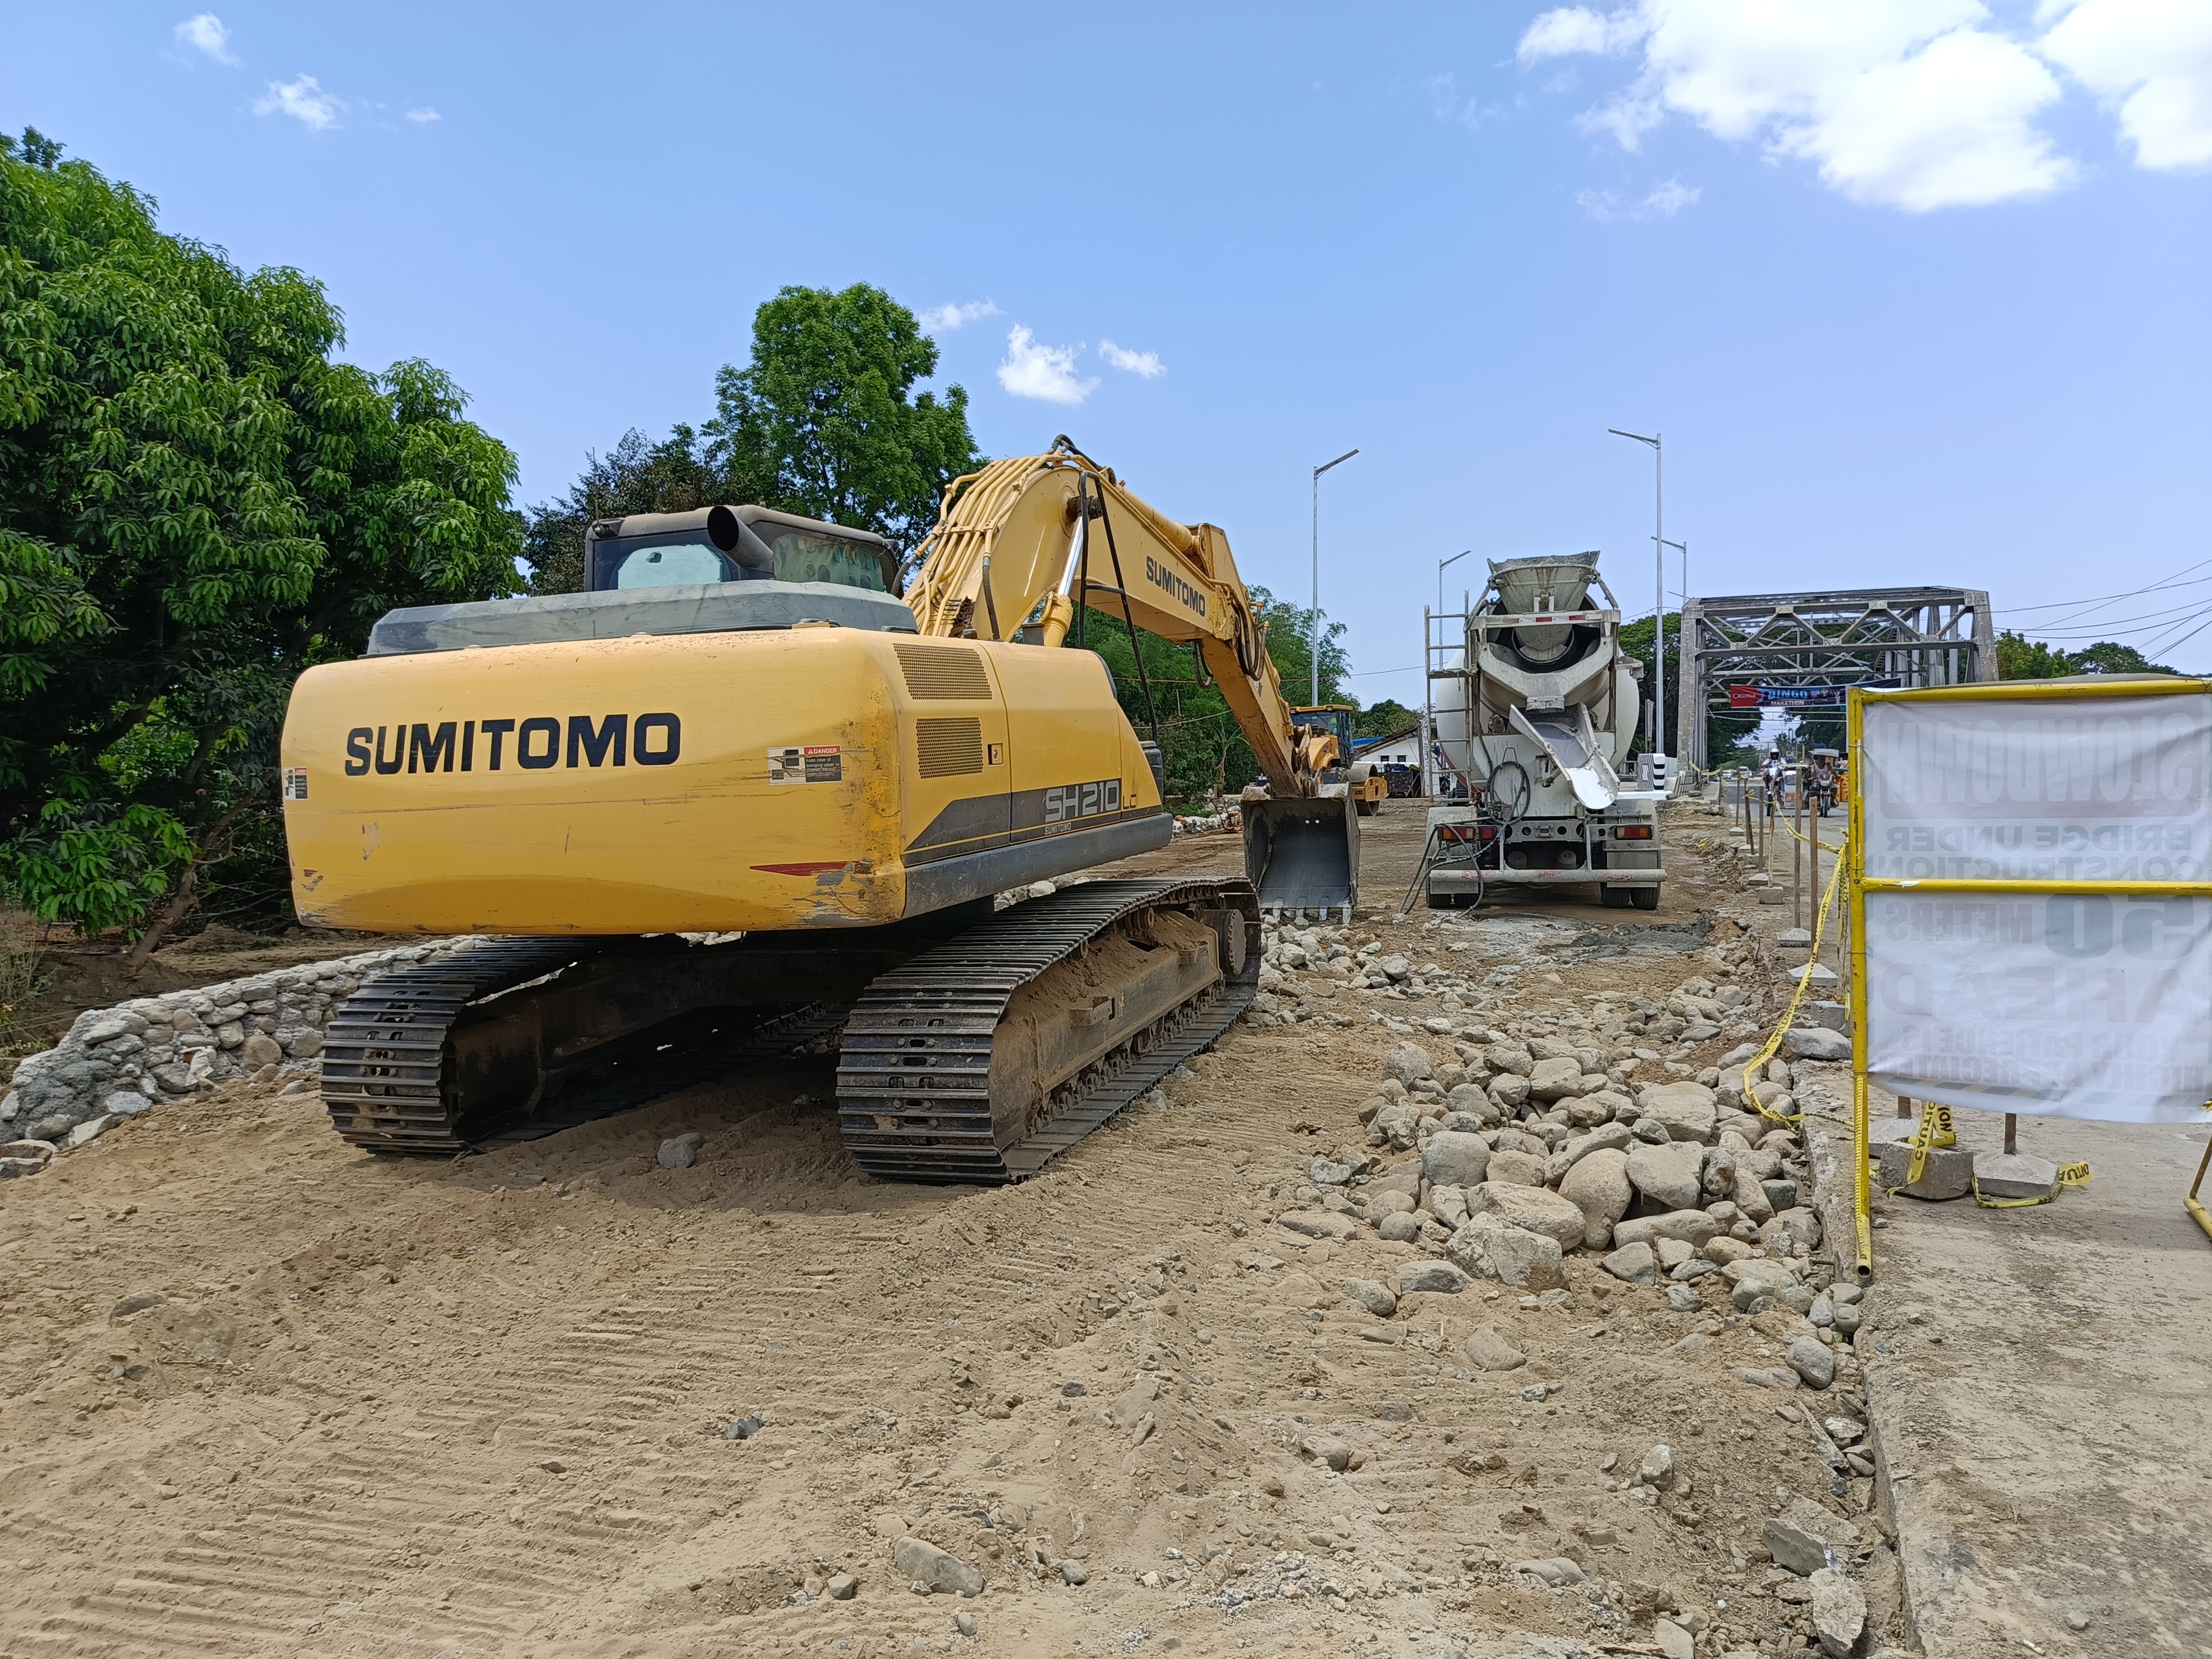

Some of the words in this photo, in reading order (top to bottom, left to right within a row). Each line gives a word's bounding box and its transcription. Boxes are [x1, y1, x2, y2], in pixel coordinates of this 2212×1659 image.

[1146, 555, 1206, 618] SUMITOMO
[345, 712, 681, 776] SUMITOMO
[1123, 794, 1137, 810] LC
[1044, 822, 1072, 835] SUMITOMO
[1937, 1105, 1953, 1133] ION
